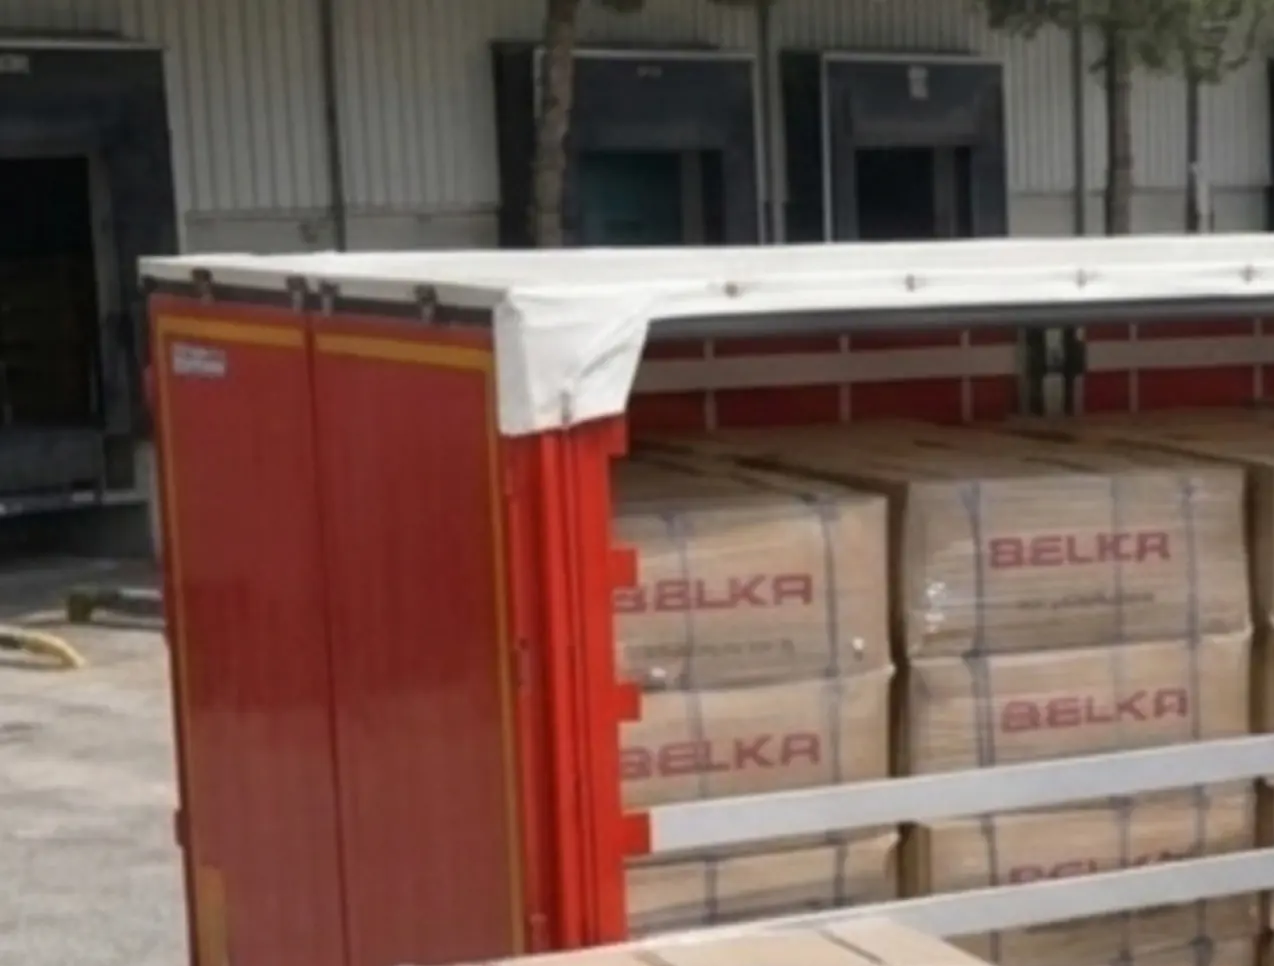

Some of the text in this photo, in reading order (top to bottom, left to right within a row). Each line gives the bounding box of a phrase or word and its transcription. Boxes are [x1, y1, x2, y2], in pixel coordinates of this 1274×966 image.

[989, 531, 1171, 569] BELKA
[1001, 687, 1188, 733] BELKA
[620, 731, 821, 781] BELKA
